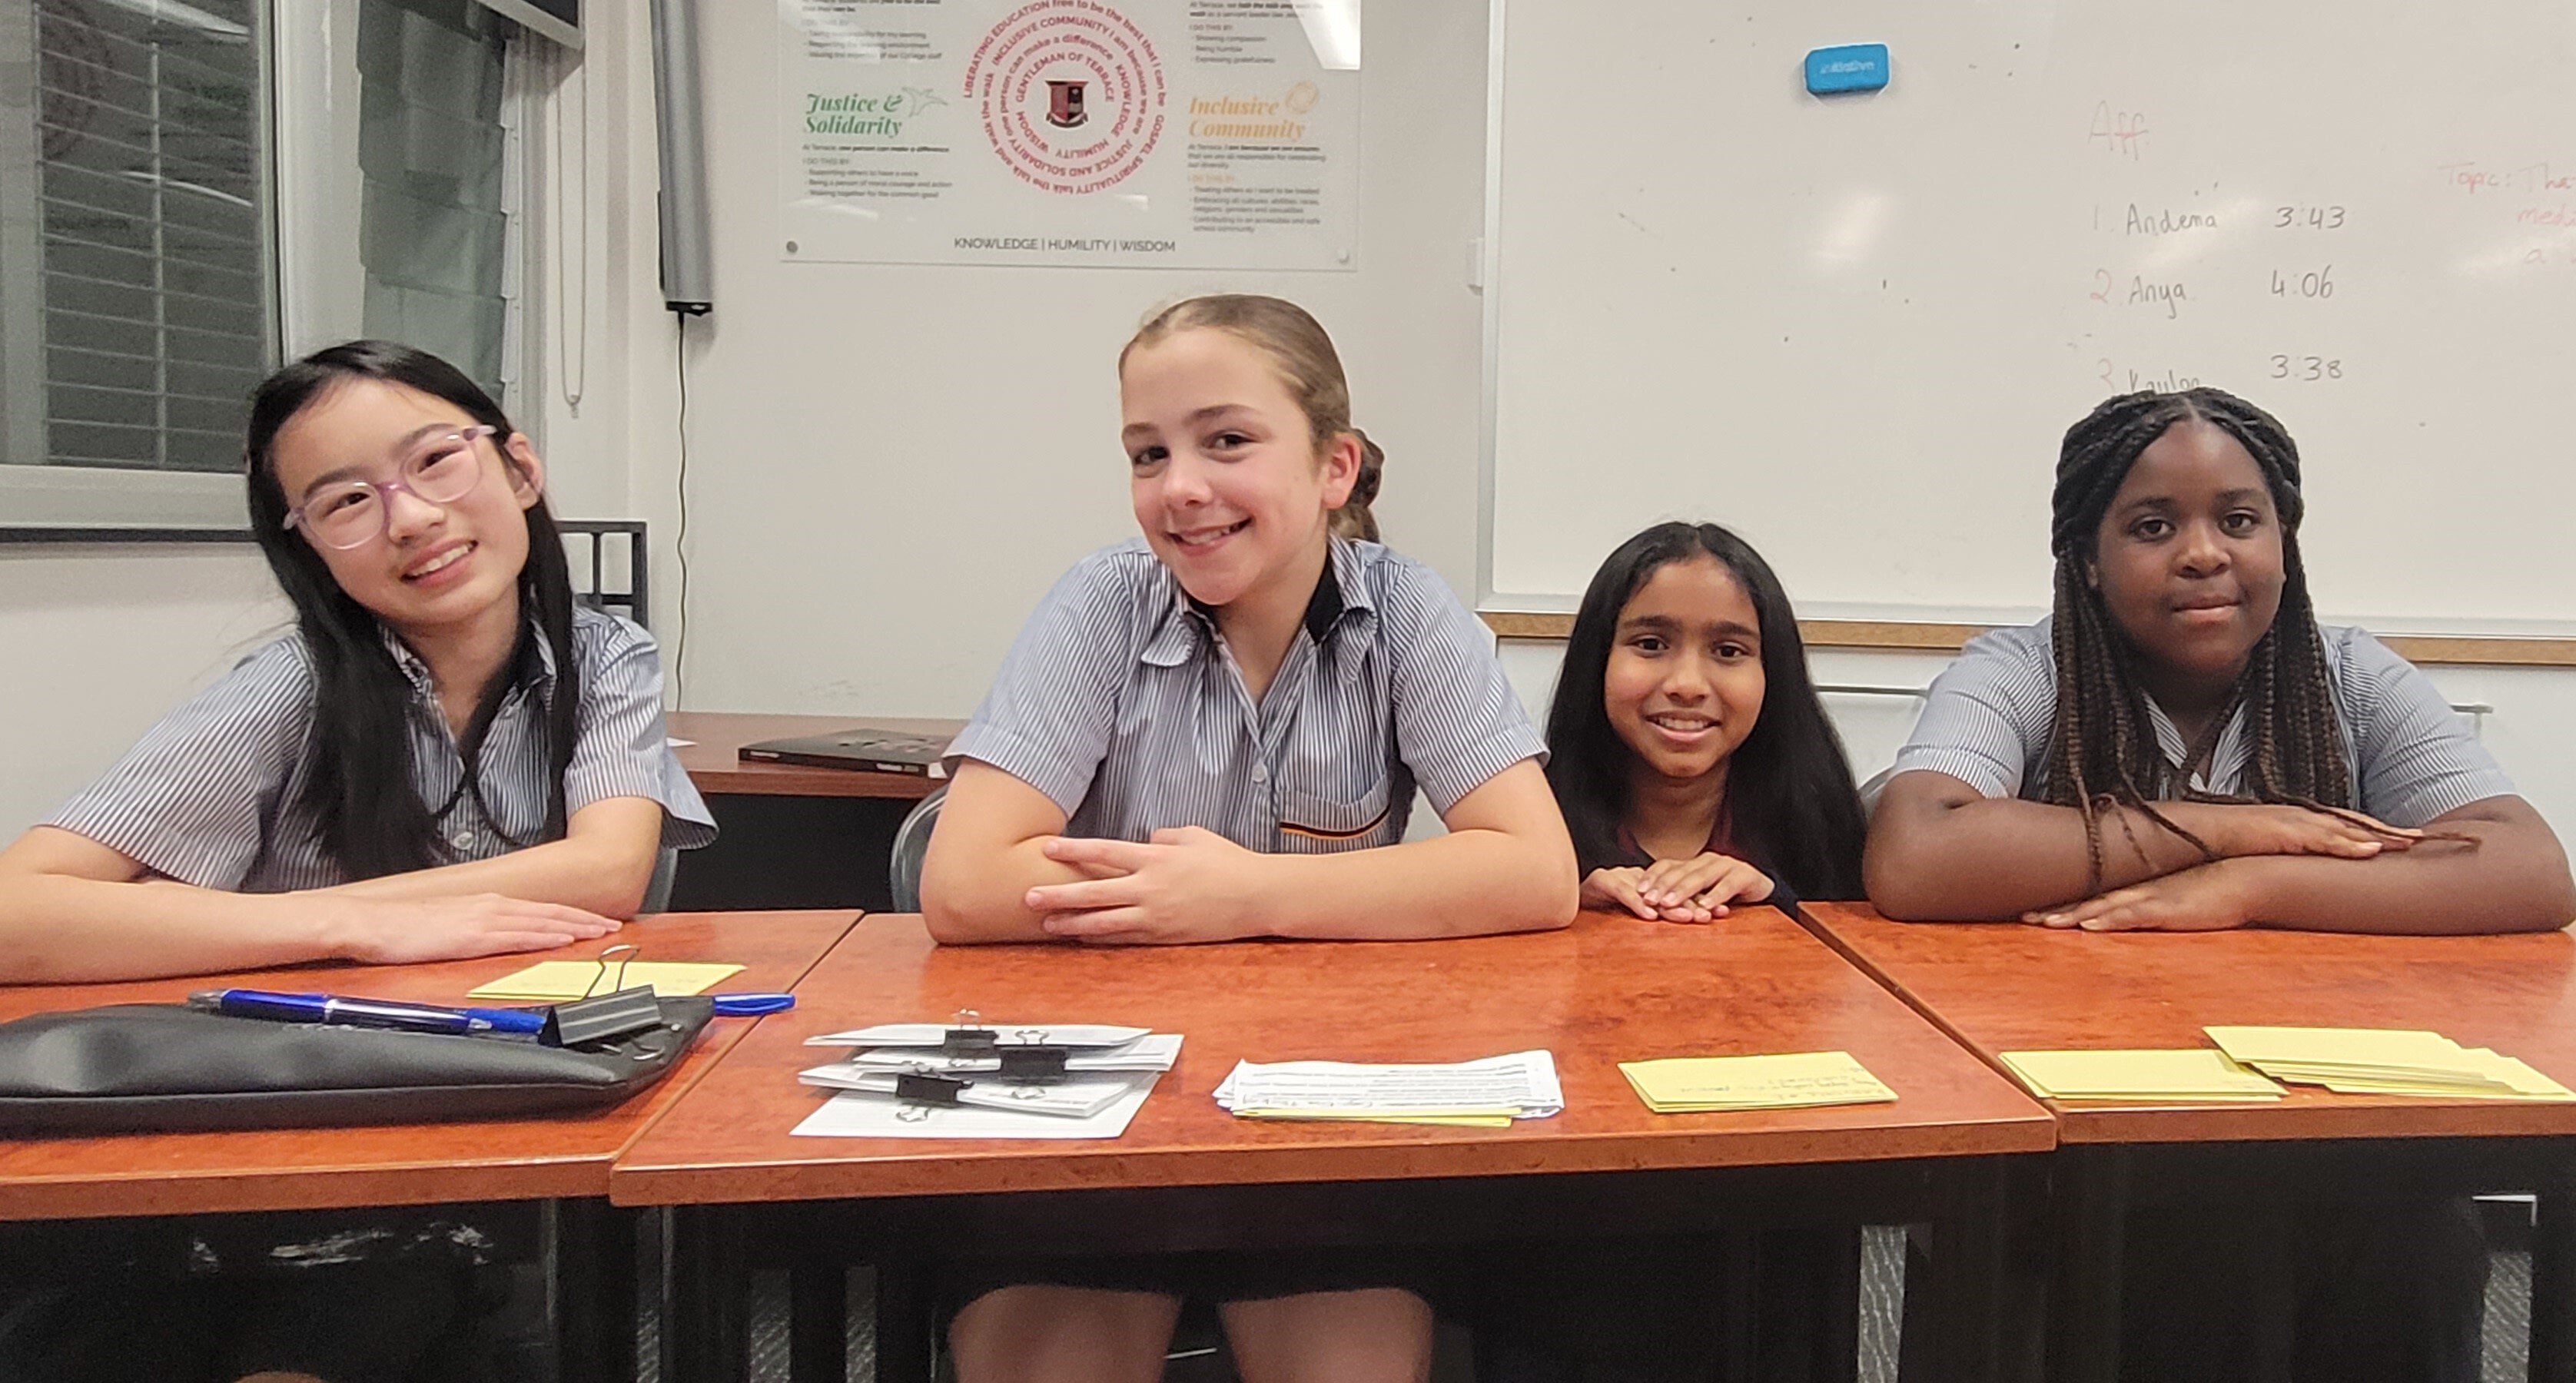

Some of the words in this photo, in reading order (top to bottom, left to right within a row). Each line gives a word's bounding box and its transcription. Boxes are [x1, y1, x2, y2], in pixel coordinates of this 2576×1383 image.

[963, 36, 994, 98] LIBERATING
[991, 1, 1049, 37] EDUCATION
[1090, 2, 1104, 13] be
[1106, 8, 1122, 22] the
[1123, 18, 1144, 41] best
[1141, 39, 1158, 61] that
[991, 22, 1038, 66] INCLUSIVE
[1040, 16, 1110, 35] COMMUNITY
[1127, 49, 1147, 96] because
[1015, 52, 1065, 102] GENTLEMAN
[1068, 51, 1084, 62] OF
[1084, 56, 1114, 101] TERRACE
[805, 93, 878, 115] Justice
[884, 95, 904, 113] &
[1110, 64, 1131, 138] KNOWLEDGE
[1189, 96, 1280, 115] Inclusive
[805, 115, 903, 139] Solidarity
[1016, 111, 1048, 153] WISDOM
[1140, 114, 1164, 154] GOSPEL
[1189, 120, 1306, 142] Community
[1008, 138, 1066, 177] SOLIDARITY
[1055, 138, 1110, 159] HUMILITY
[1095, 138, 1134, 172] JUSTICE
[1069, 166, 1092, 177] AND
[1076, 155, 1144, 194] SPIRITUALITY
[2274, 202, 2345, 230] 3:43
[954, 238, 1038, 250] KNOWLEDGE
[1047, 239, 1111, 250] HUMILITY
[1119, 240, 1176, 252] WISDOM
[2129, 275, 2186, 319] Anya
[2272, 265, 2333, 299] 4:06
[2270, 354, 2343, 381] 3:38
